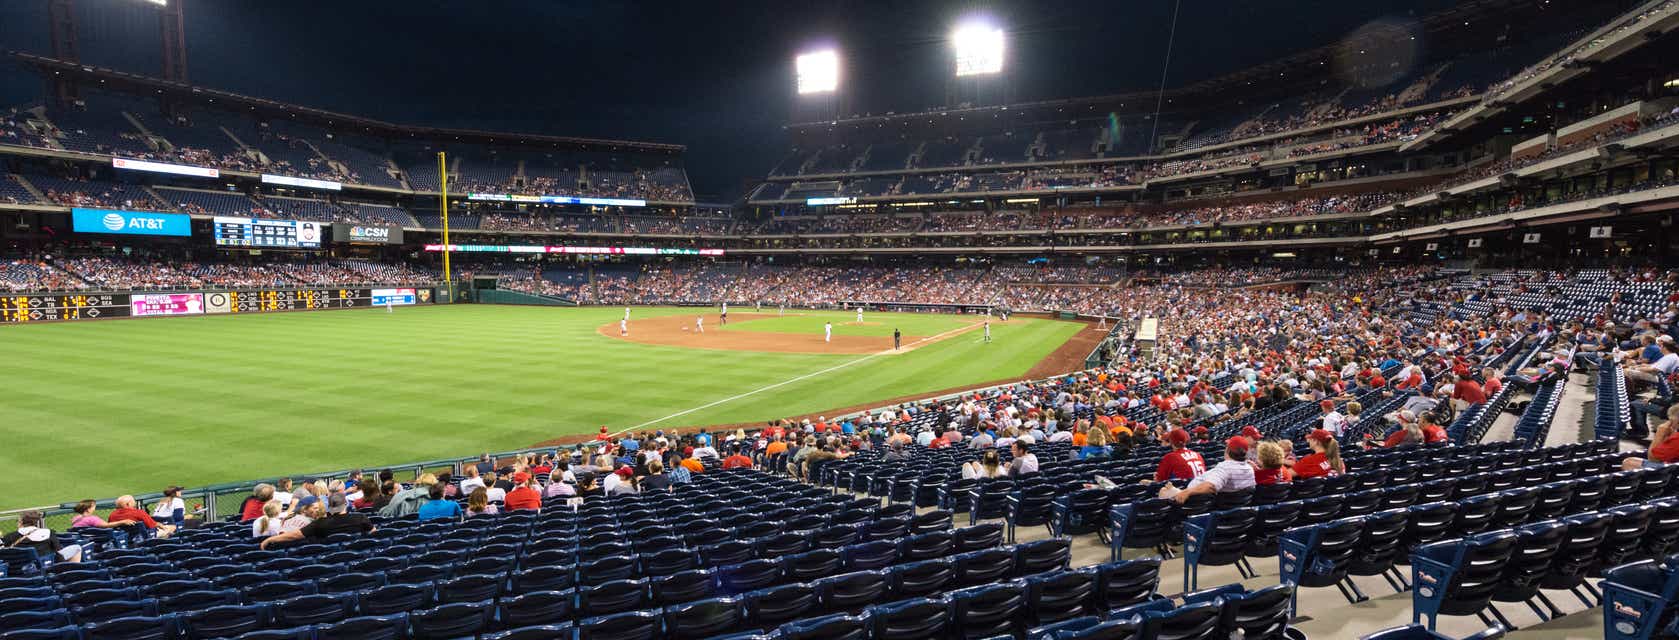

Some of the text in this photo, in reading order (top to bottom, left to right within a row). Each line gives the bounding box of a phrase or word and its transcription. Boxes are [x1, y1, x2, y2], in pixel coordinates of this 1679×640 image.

[129, 217, 165, 229] AT&T
[365, 227, 389, 237] CSN
[1188, 460, 1204, 478] 15
